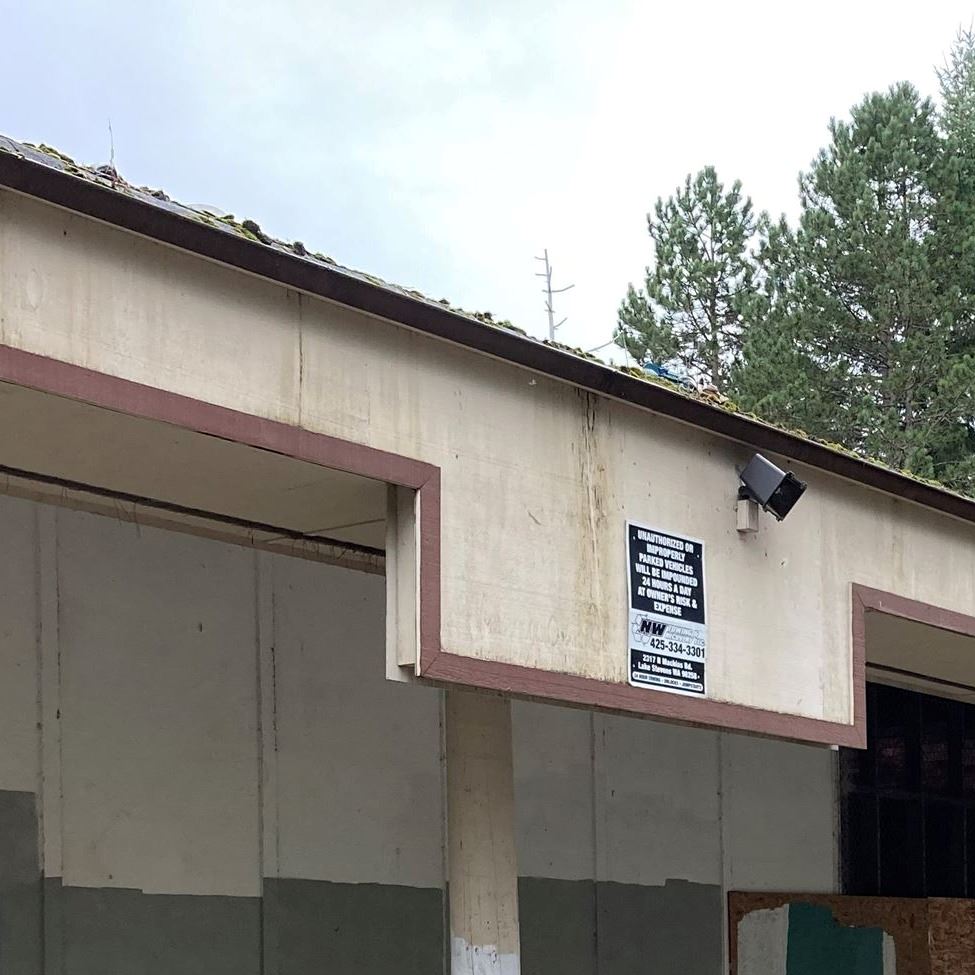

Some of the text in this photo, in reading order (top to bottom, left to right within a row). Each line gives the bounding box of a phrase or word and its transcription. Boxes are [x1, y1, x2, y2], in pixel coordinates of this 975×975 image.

[637, 529, 694, 554] UNAUTHORIZED OR
[646, 543, 686, 562] IMPROPERLY
[638, 552, 694, 575] PARKED VEHICLES
[635, 562, 698, 587] WILL BE IMPOUNDED
[642, 576, 692, 596] 24 HOURS A DAY
[637, 586, 698, 609] AT OWNER'S RISK &
[653, 601, 682, 616] EXPENSE
[640, 620, 666, 636] NW
[650, 638, 705, 658] 425-334-3301
[638, 661, 651, 671] Lake
[651, 664, 672, 675] Stevens
